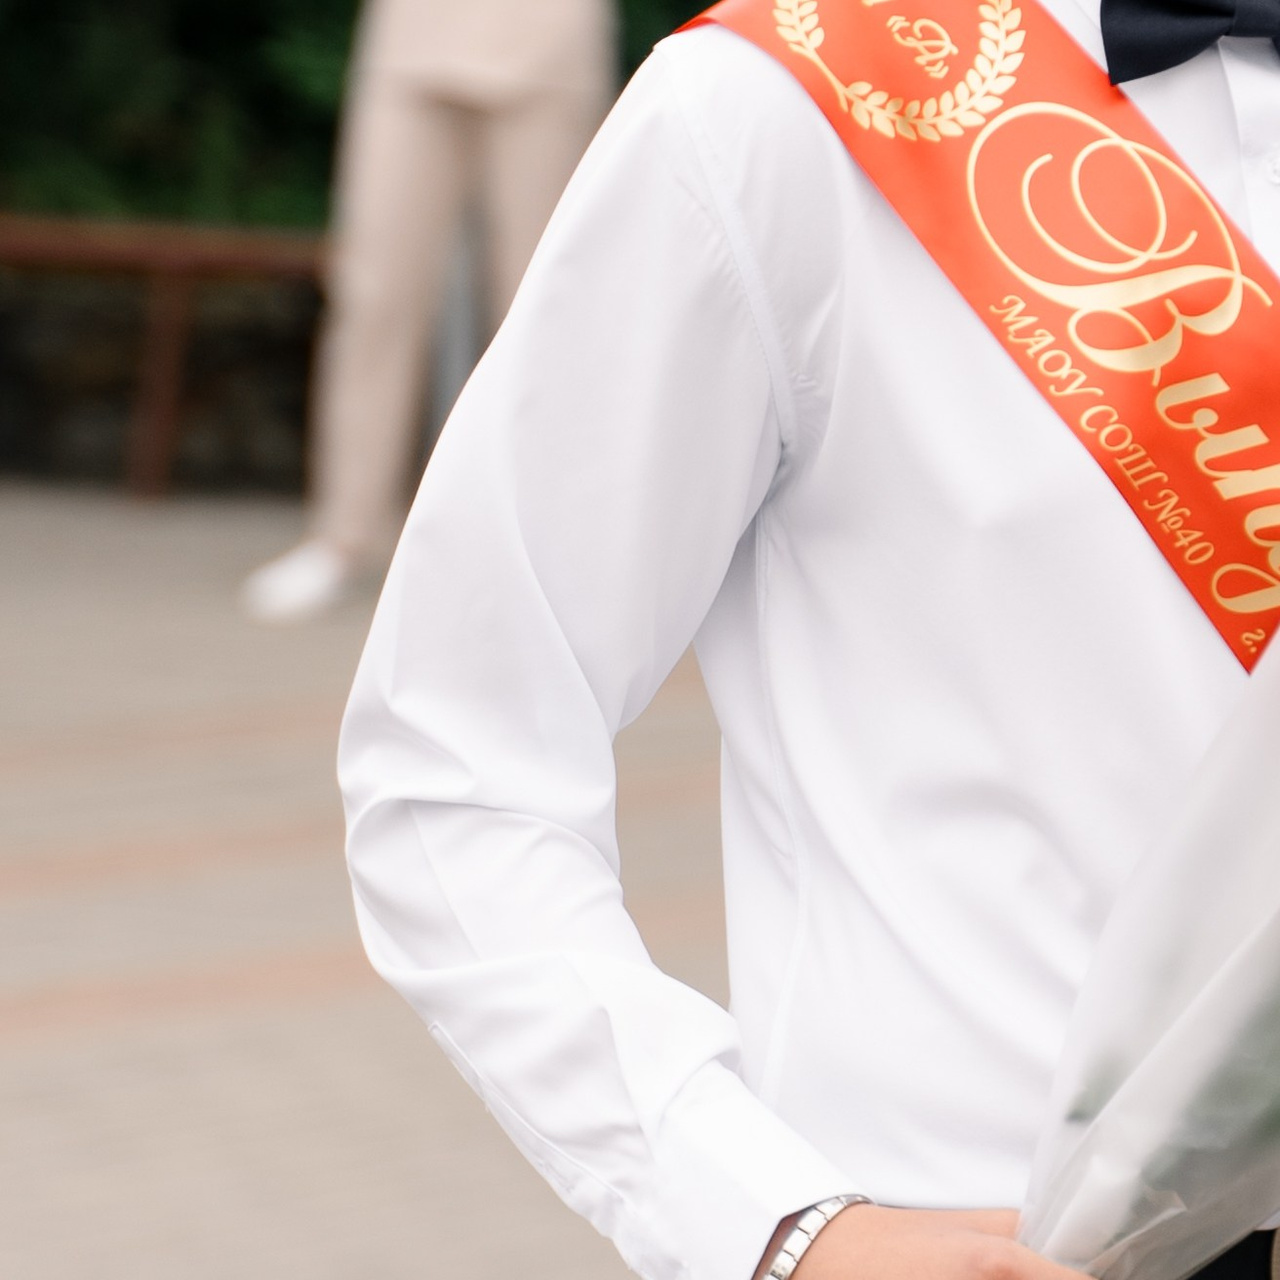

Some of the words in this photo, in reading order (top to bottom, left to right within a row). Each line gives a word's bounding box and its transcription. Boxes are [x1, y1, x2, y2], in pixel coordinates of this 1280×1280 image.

[989, 294, 1105, 397] МАОУ
[1079, 404, 1169, 490] СОШ
[1143, 489, 1215, 565] №40
